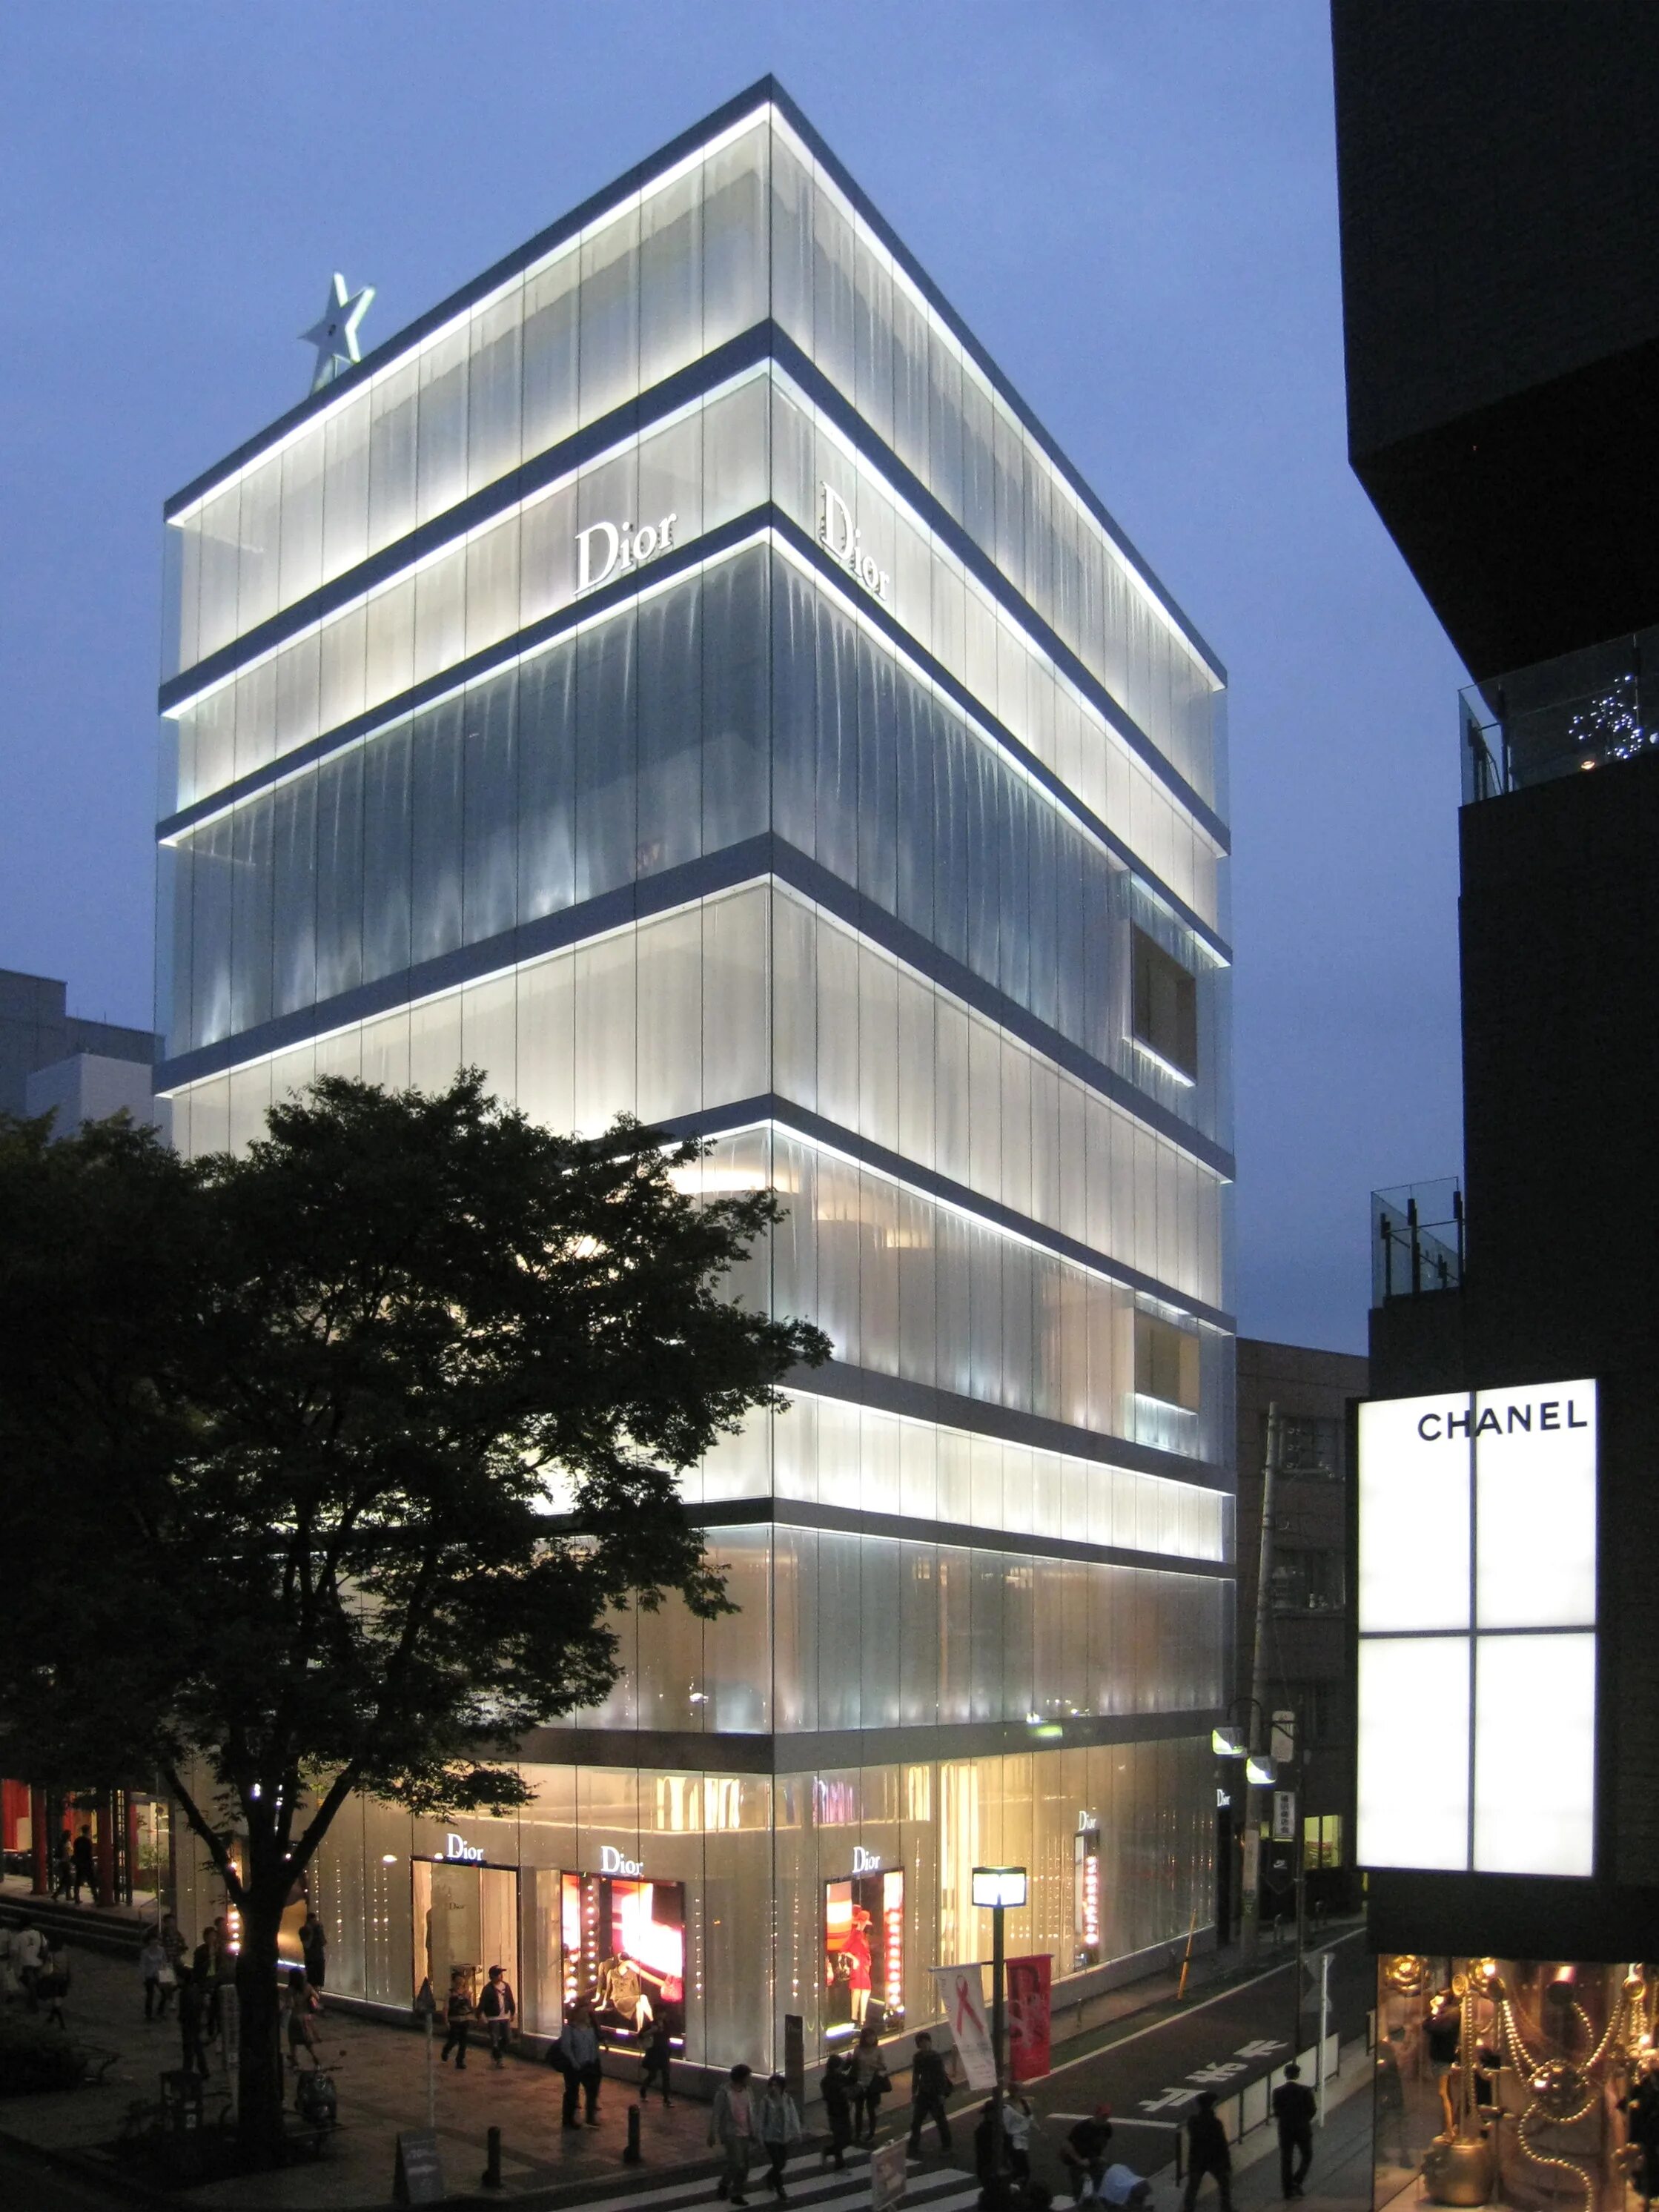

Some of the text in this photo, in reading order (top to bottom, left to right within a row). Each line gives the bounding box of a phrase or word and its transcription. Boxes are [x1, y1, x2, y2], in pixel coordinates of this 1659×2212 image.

[573, 513, 677, 596] Dior
[820, 481, 890, 600] Dior
[1418, 1400, 1588, 1442] CHANEL
[1079, 1810, 1096, 1832] Dior
[447, 1833, 484, 1861] Dior
[600, 1846, 644, 1877] Dior
[852, 1847, 880, 1873] Dior
